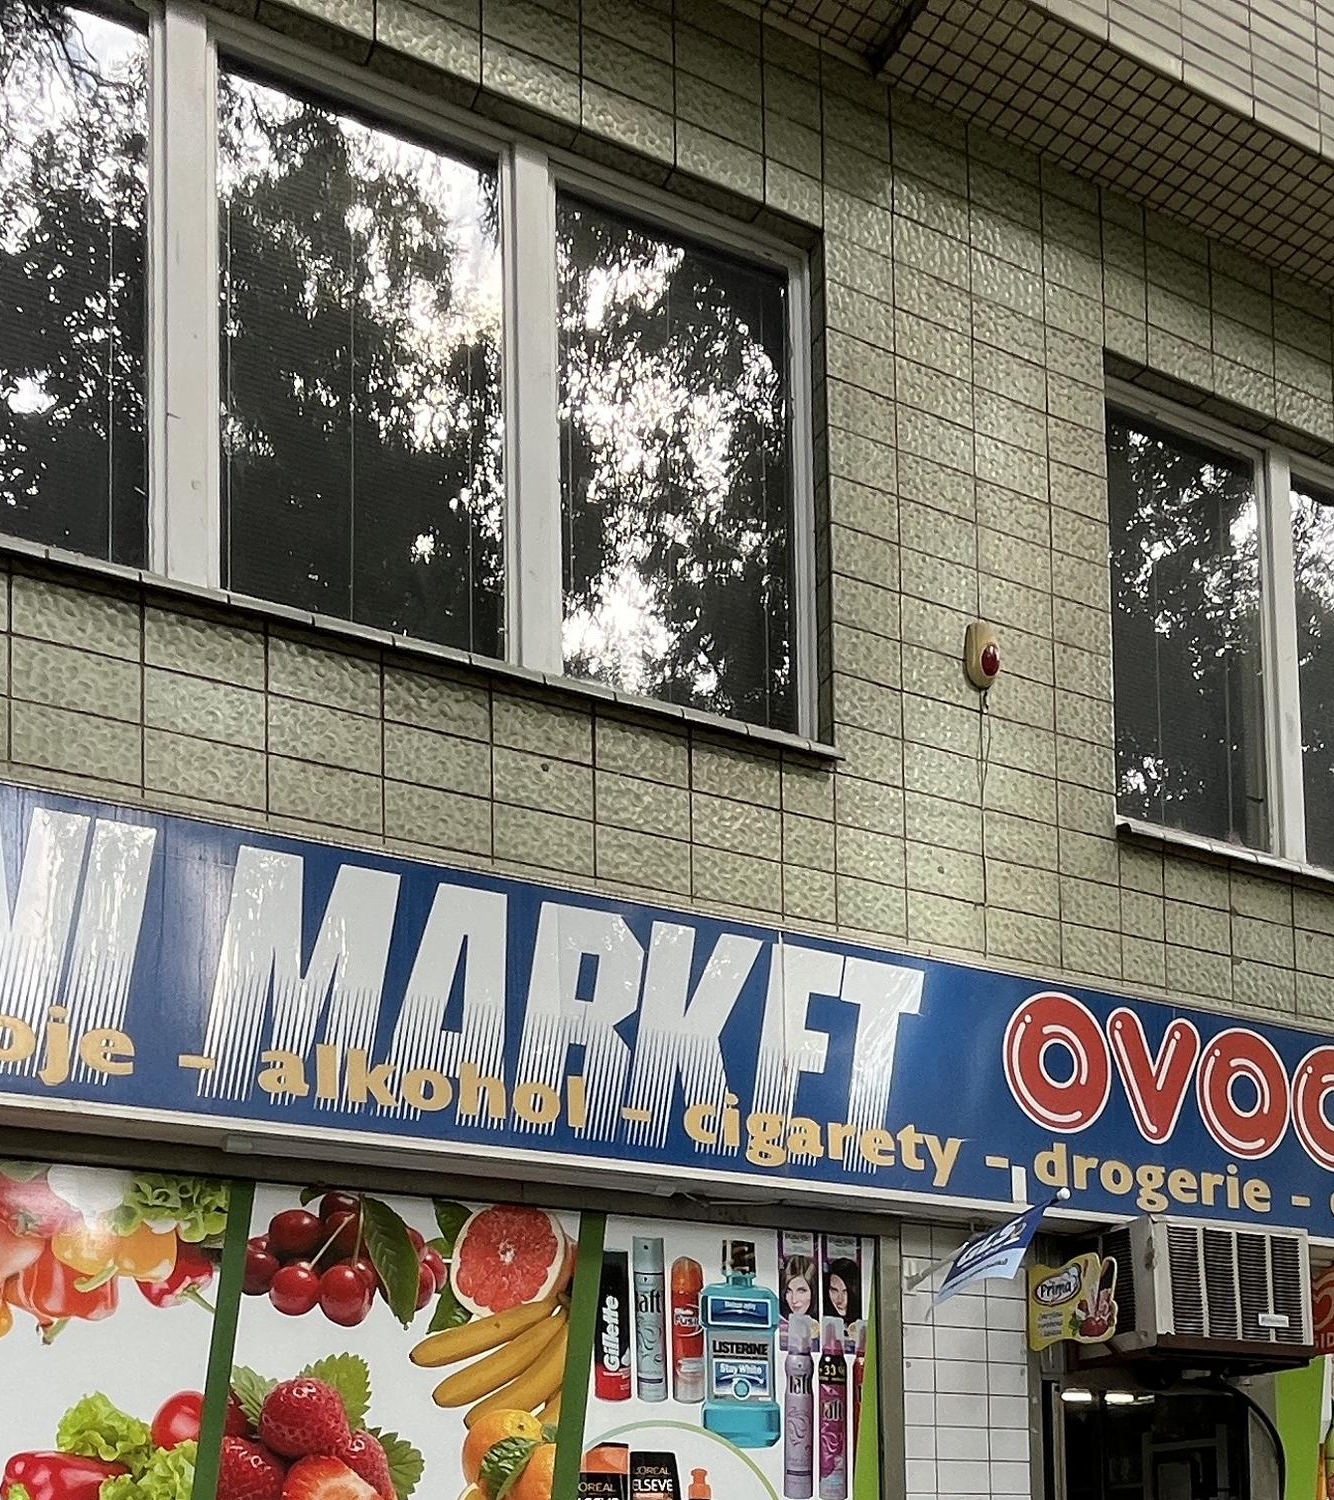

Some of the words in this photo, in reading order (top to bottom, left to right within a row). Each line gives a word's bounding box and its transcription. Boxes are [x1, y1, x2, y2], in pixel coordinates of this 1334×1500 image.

[198, 845, 925, 1173] MARKET
[258, 1044, 587, 1129] alkohol
[683, 1092, 963, 1187] cigarety
[1033, 1141, 1272, 1214] drogerie
[1040, 1281, 1072, 1298] Prima
[601, 1294, 620, 1372] Gillette
[712, 1339, 769, 1356] LISTERINE
[632, 1478, 673, 1492] ELSEVE
